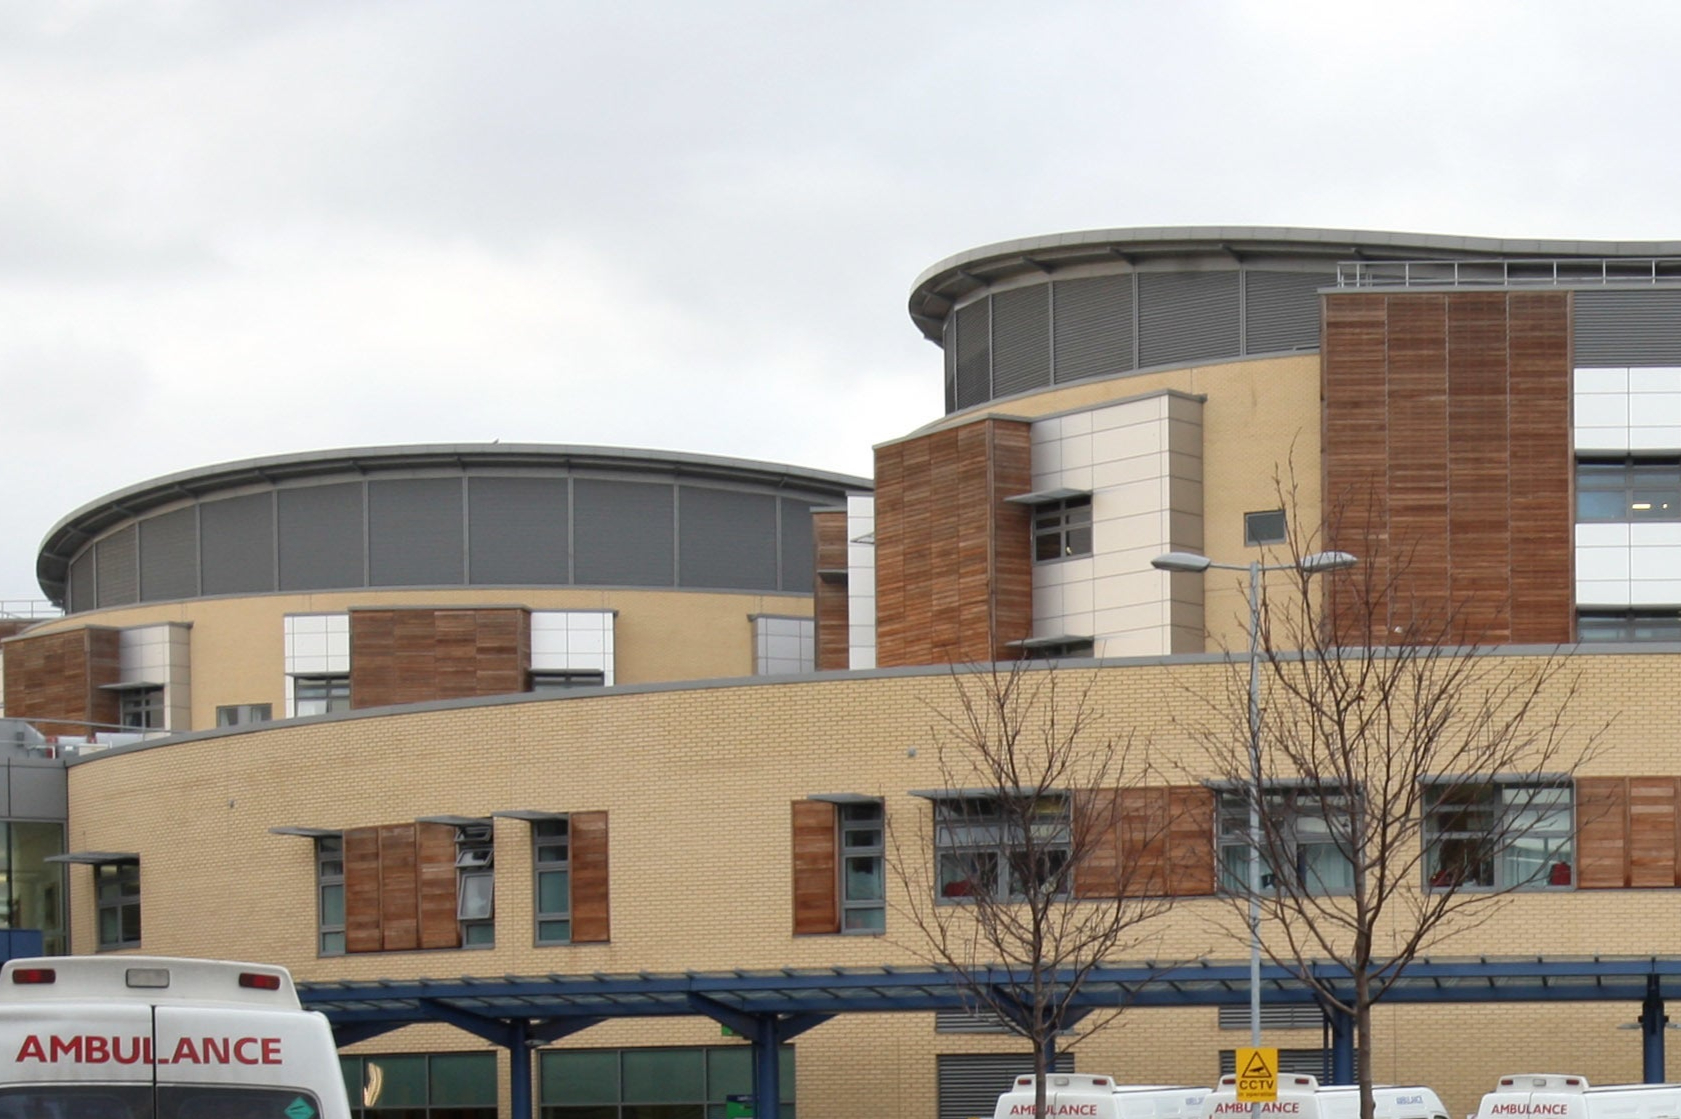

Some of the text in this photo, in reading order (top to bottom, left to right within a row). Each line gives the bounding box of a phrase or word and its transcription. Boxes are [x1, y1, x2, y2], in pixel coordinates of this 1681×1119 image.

[15, 1035, 283, 1065] AMBULANCE
[1239, 1080, 1274, 1090] CCTV
[1215, 1102, 1299, 1113] AMBUANCE
[1491, 1103, 1568, 1116] AMBULANCE
